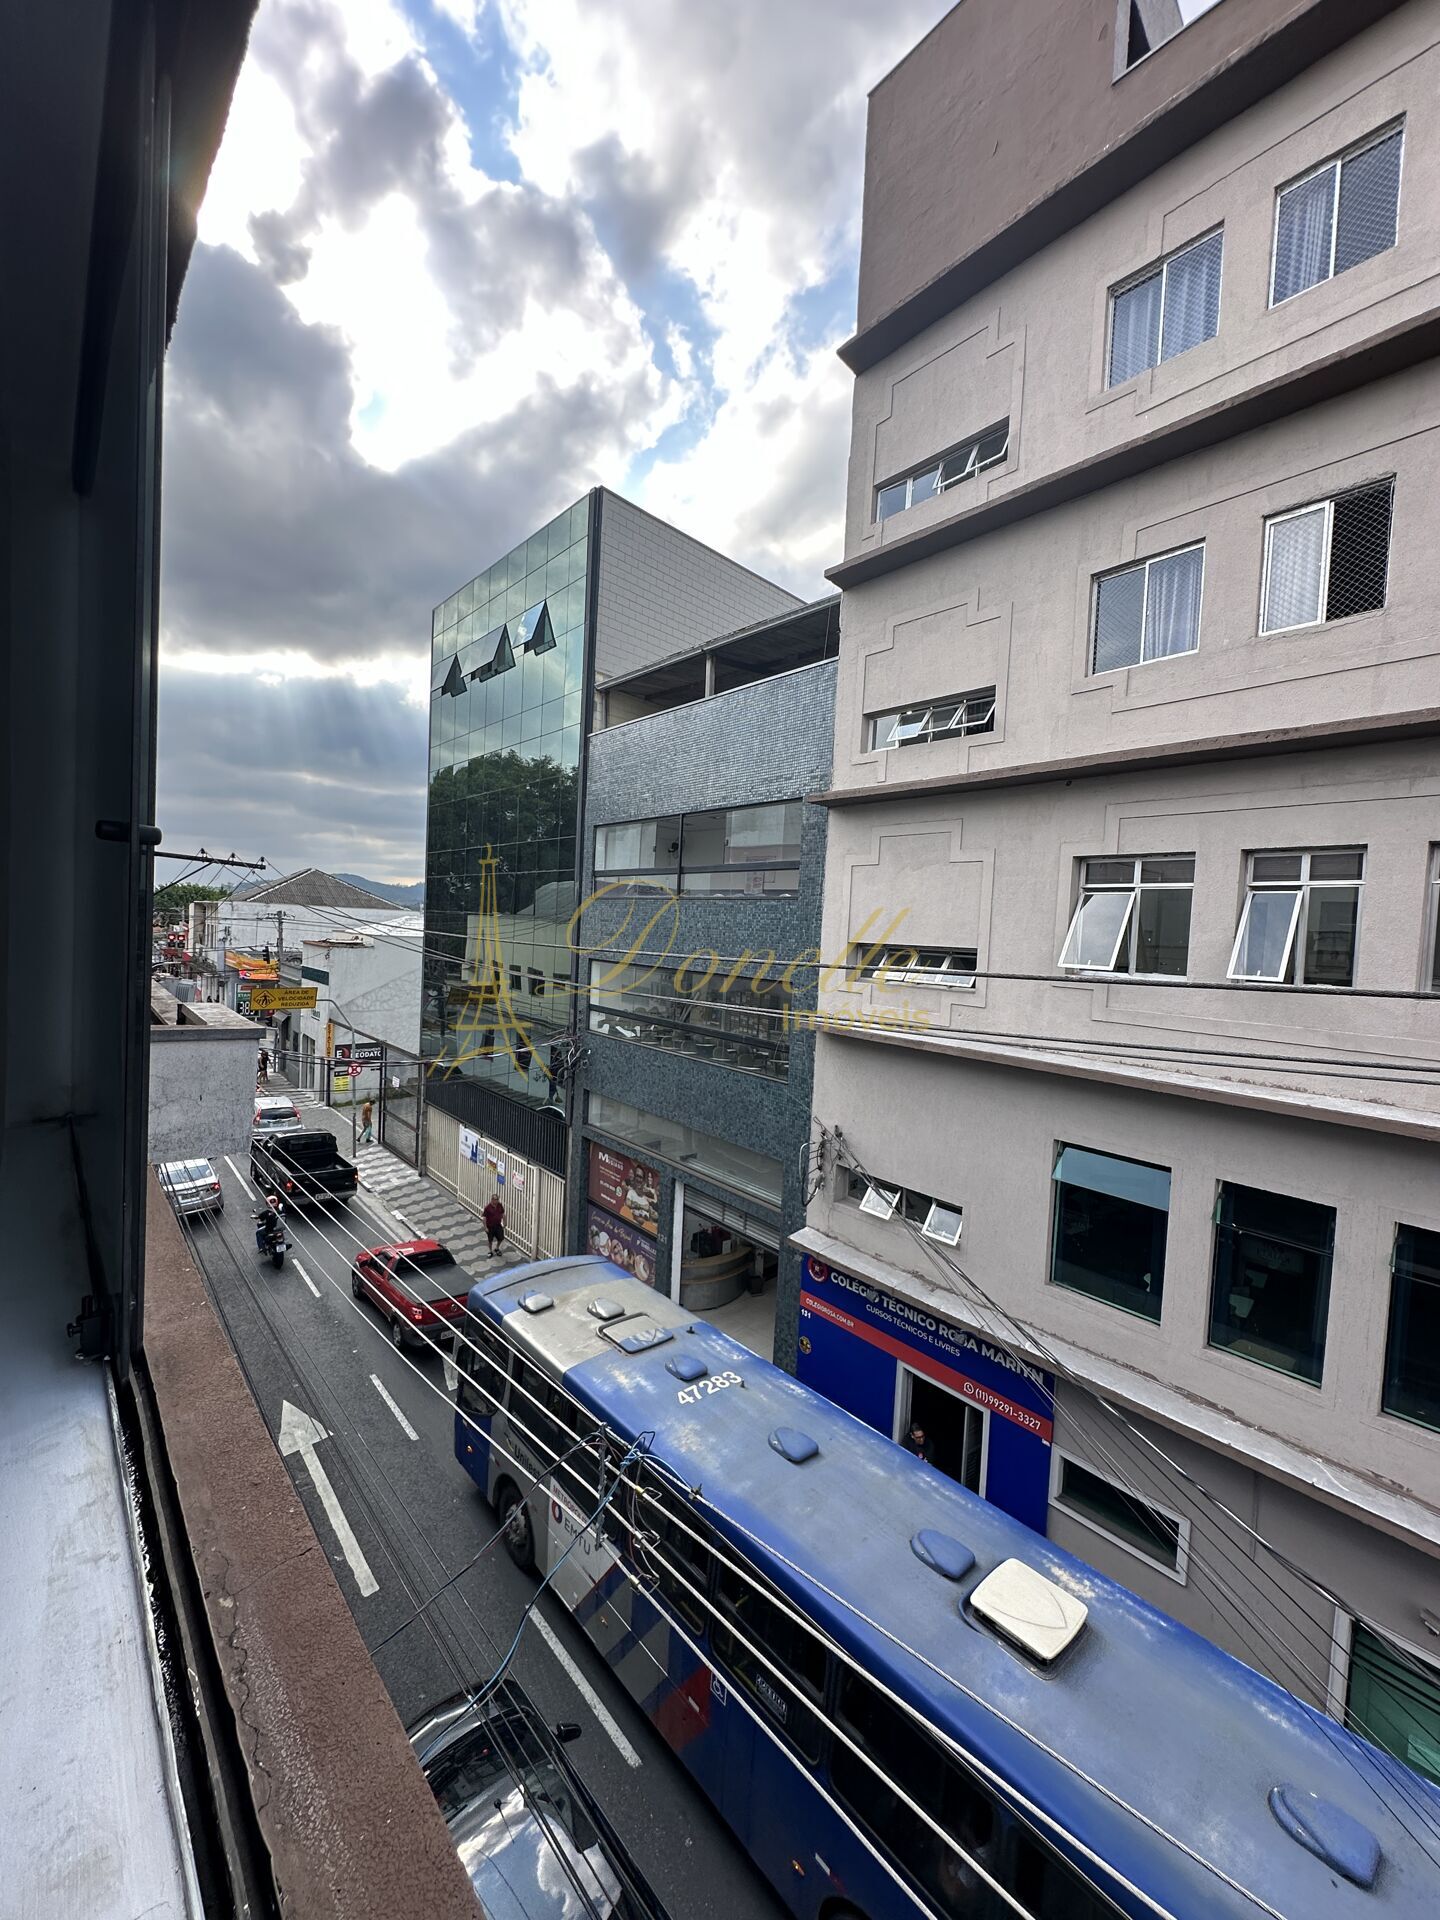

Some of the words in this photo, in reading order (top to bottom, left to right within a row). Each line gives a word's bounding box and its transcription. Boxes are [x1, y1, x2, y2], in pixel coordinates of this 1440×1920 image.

[801, 1308, 811, 1319] 131
[865, 1304, 893, 1322] CURSOS
[893, 1316, 928, 1340] TÉCNICOS
[928, 1335, 934, 1343] E
[934, 1338, 960, 1357] LIVRES
[881, 1295, 936, 1331] TÉCNICO
[677, 1371, 742, 1404] 47283
[975, 1388, 1041, 1430] (11)99291-3327
